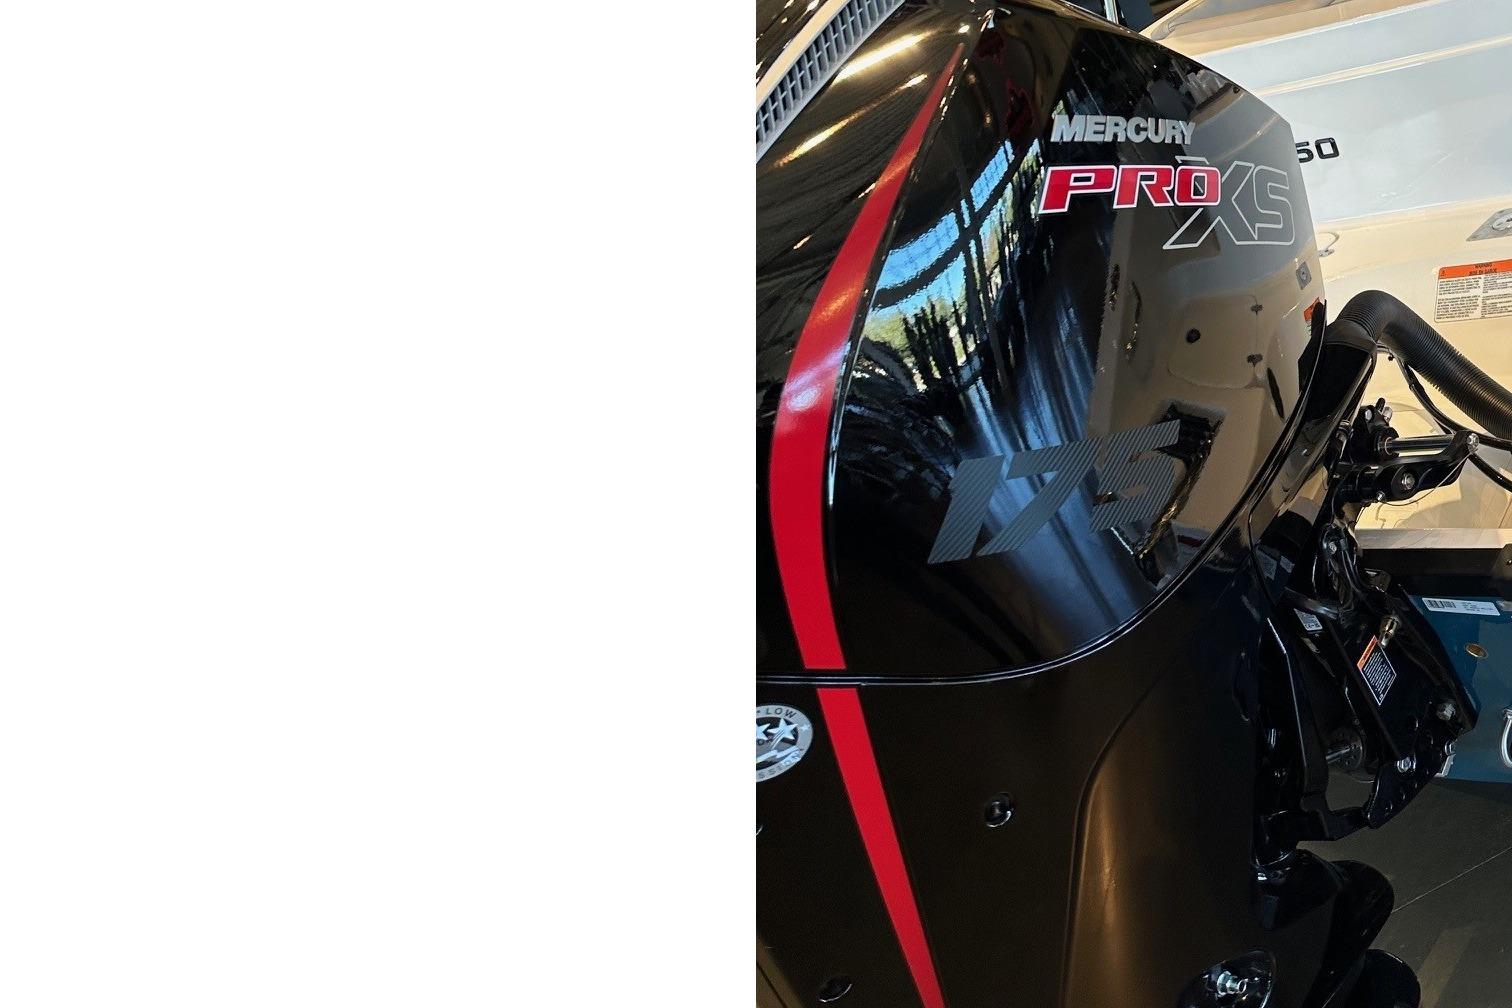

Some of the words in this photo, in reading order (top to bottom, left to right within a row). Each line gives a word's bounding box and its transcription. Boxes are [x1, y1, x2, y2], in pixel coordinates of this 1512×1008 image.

[1050, 114, 1196, 145] MERCURY
[1038, 164, 1221, 214] PRO
[1162, 155, 1295, 250] XS
[927, 419, 1182, 565] 175
